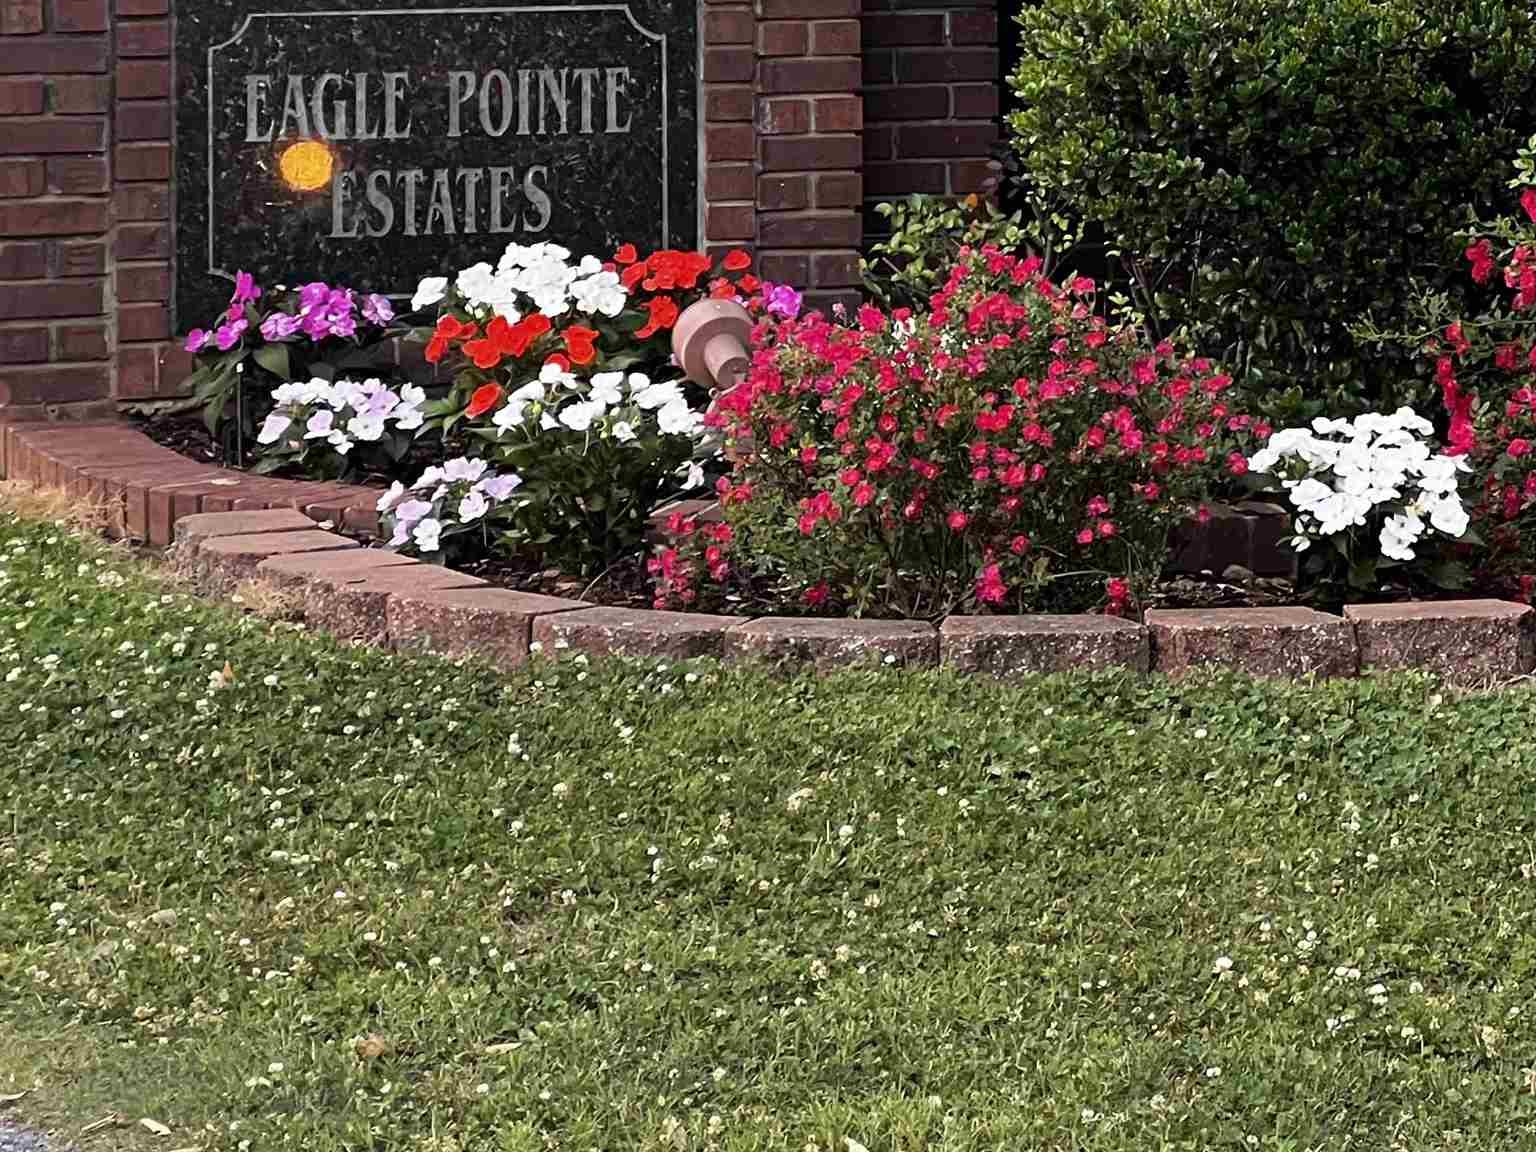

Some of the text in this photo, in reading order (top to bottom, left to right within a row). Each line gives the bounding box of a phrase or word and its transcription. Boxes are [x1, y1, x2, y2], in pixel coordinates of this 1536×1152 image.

[243, 65, 633, 144] EAGLE POINTE
[329, 164, 553, 239] ESTATES
